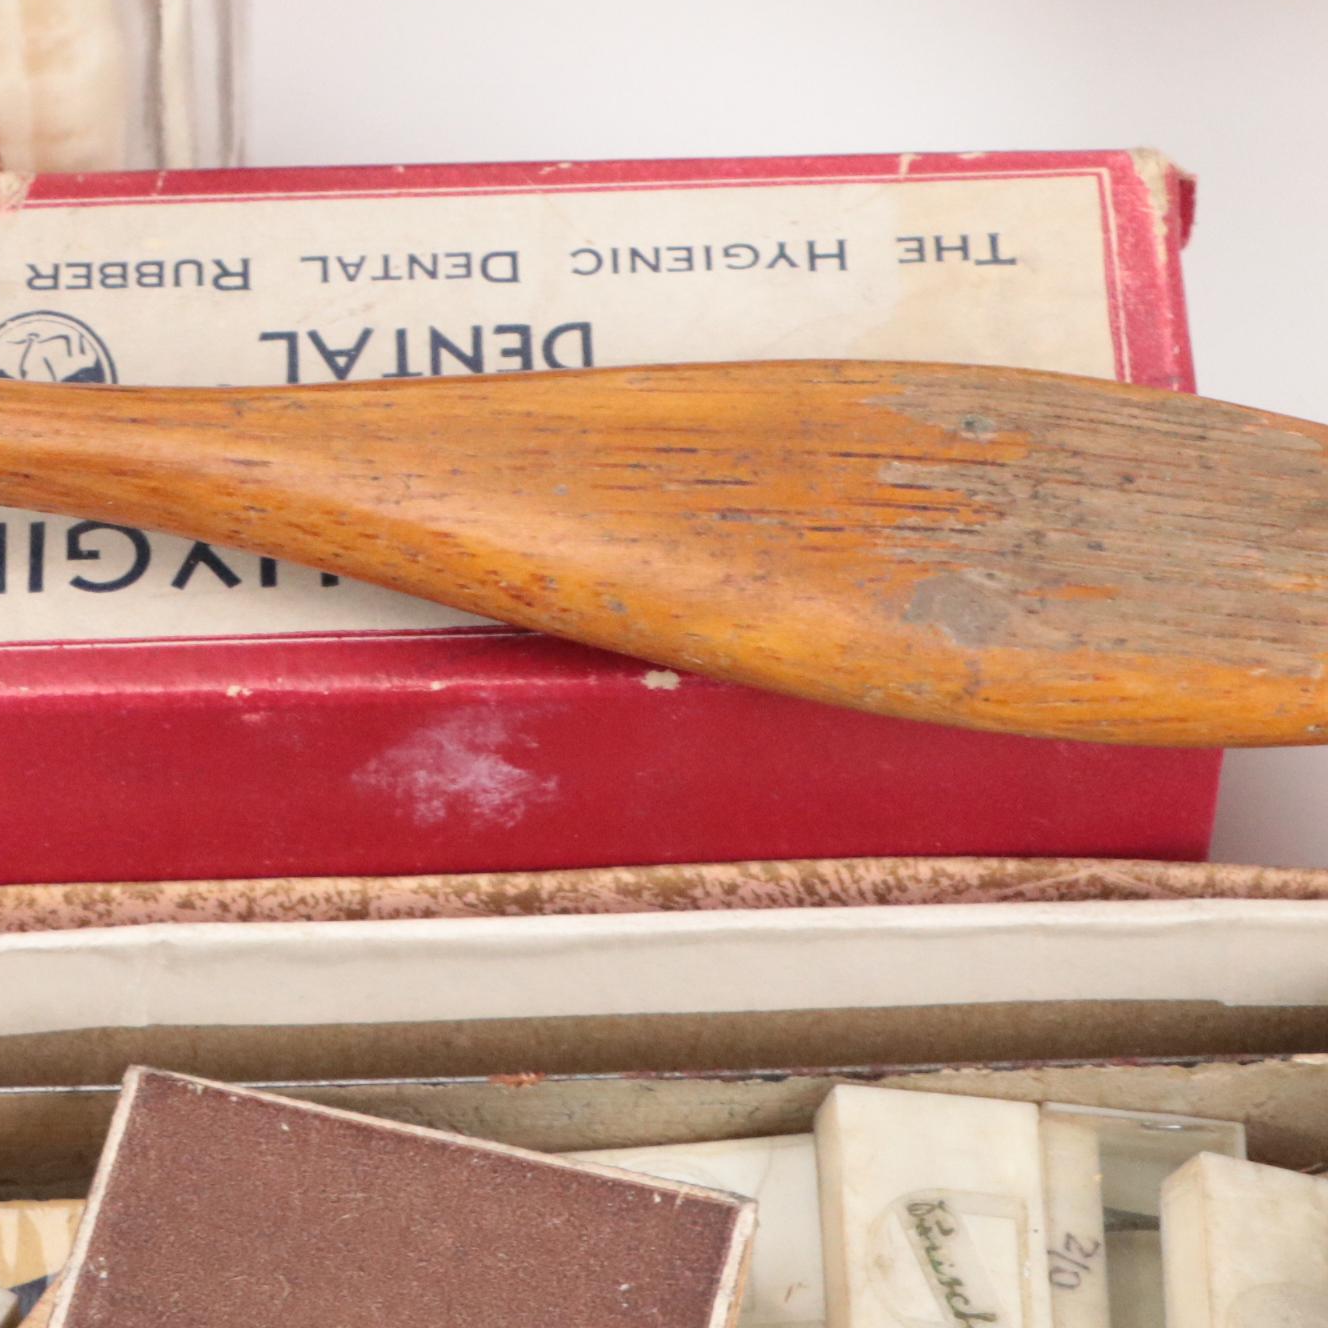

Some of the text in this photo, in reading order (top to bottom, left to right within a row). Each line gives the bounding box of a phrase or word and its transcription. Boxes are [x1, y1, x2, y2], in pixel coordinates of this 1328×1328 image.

[299, 250, 521, 284] DENTAL
[569, 238, 849, 277] HYGIENIC
[894, 232, 1018, 267] THE
[25, 257, 252, 292] RUBBER
[258, 320, 595, 385] DENTAL
